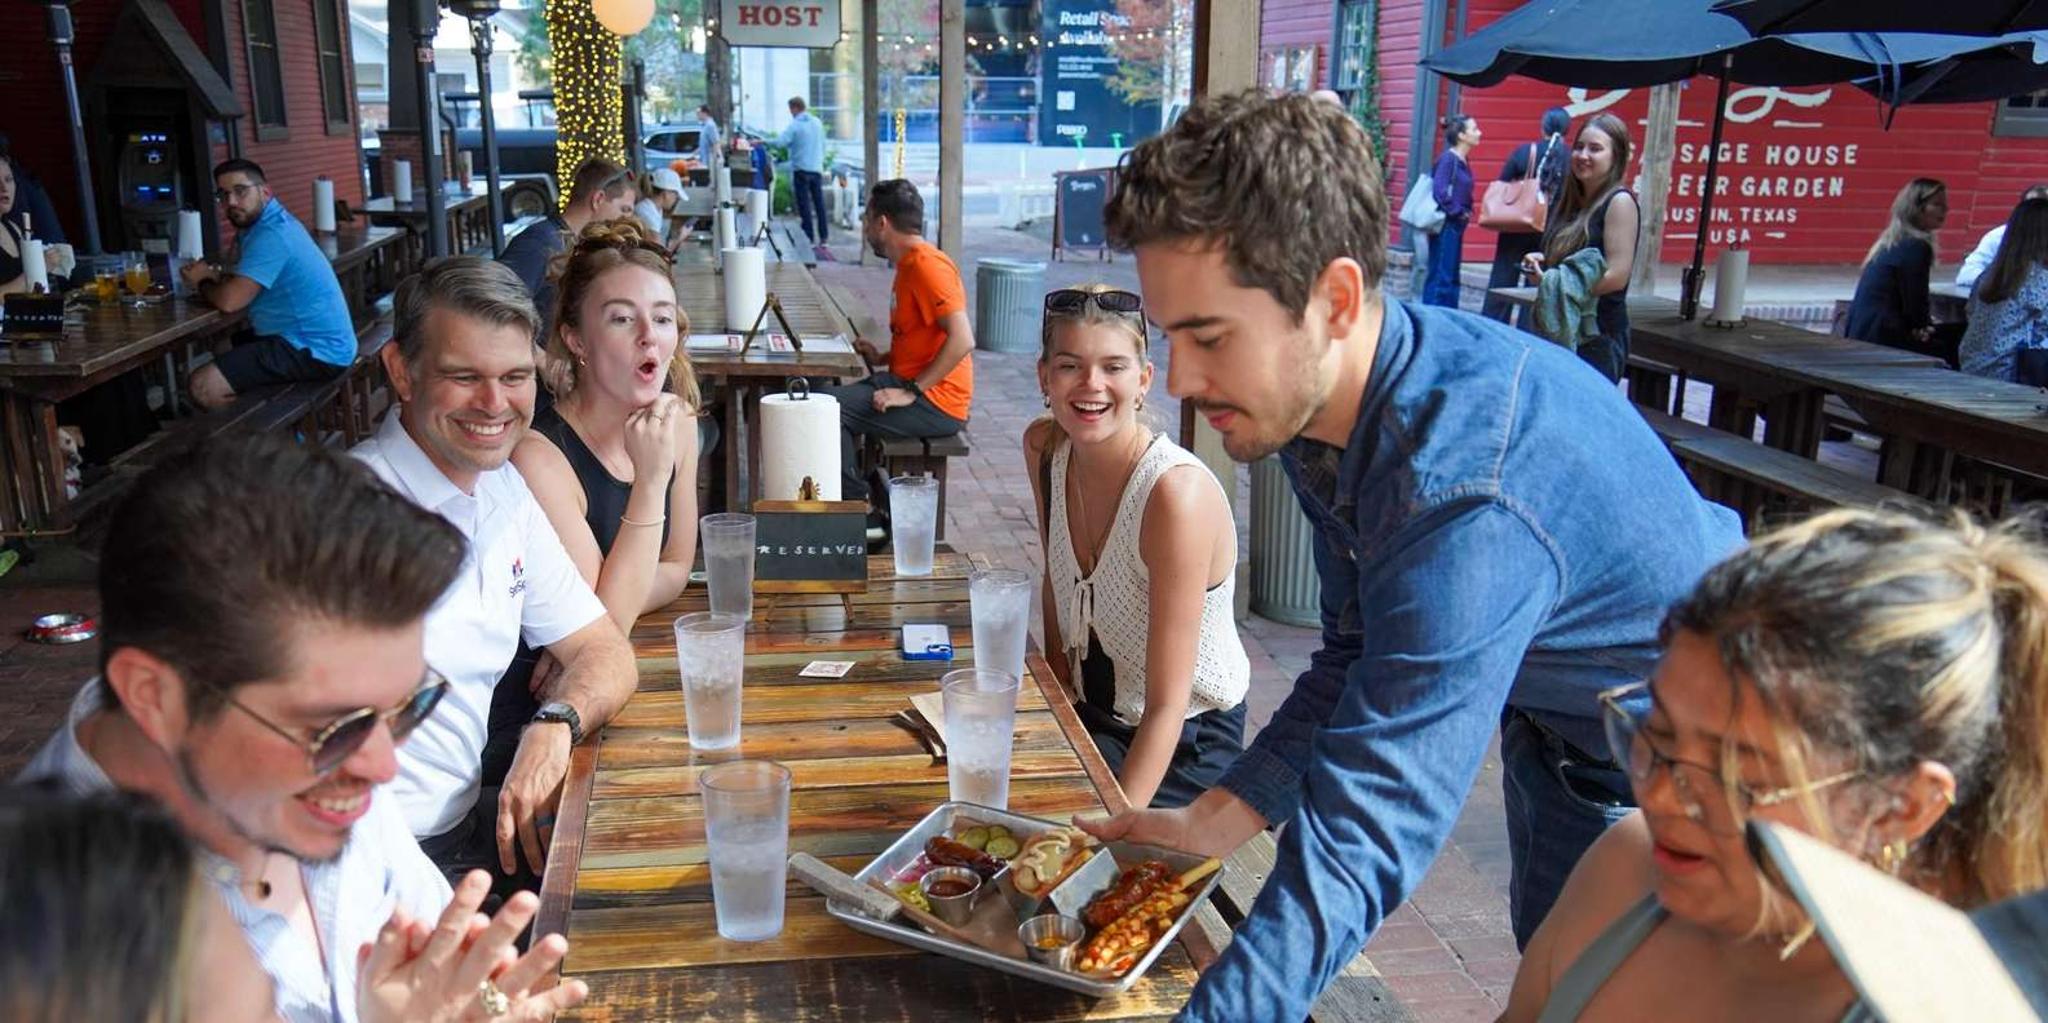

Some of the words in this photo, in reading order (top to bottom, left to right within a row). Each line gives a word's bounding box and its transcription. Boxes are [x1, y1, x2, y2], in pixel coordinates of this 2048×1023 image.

[738, 6, 823, 26] HOST
[1060, 11, 1099, 26] Retail
[1765, 144, 1858, 166] HOUSE
[1668, 174, 1729, 196] EER
[1741, 176, 1844, 197] GARDEN
[1740, 207, 1797, 223] TEXAS
[1710, 229, 1751, 244] USA
[757, 544, 864, 555] RESERVED
